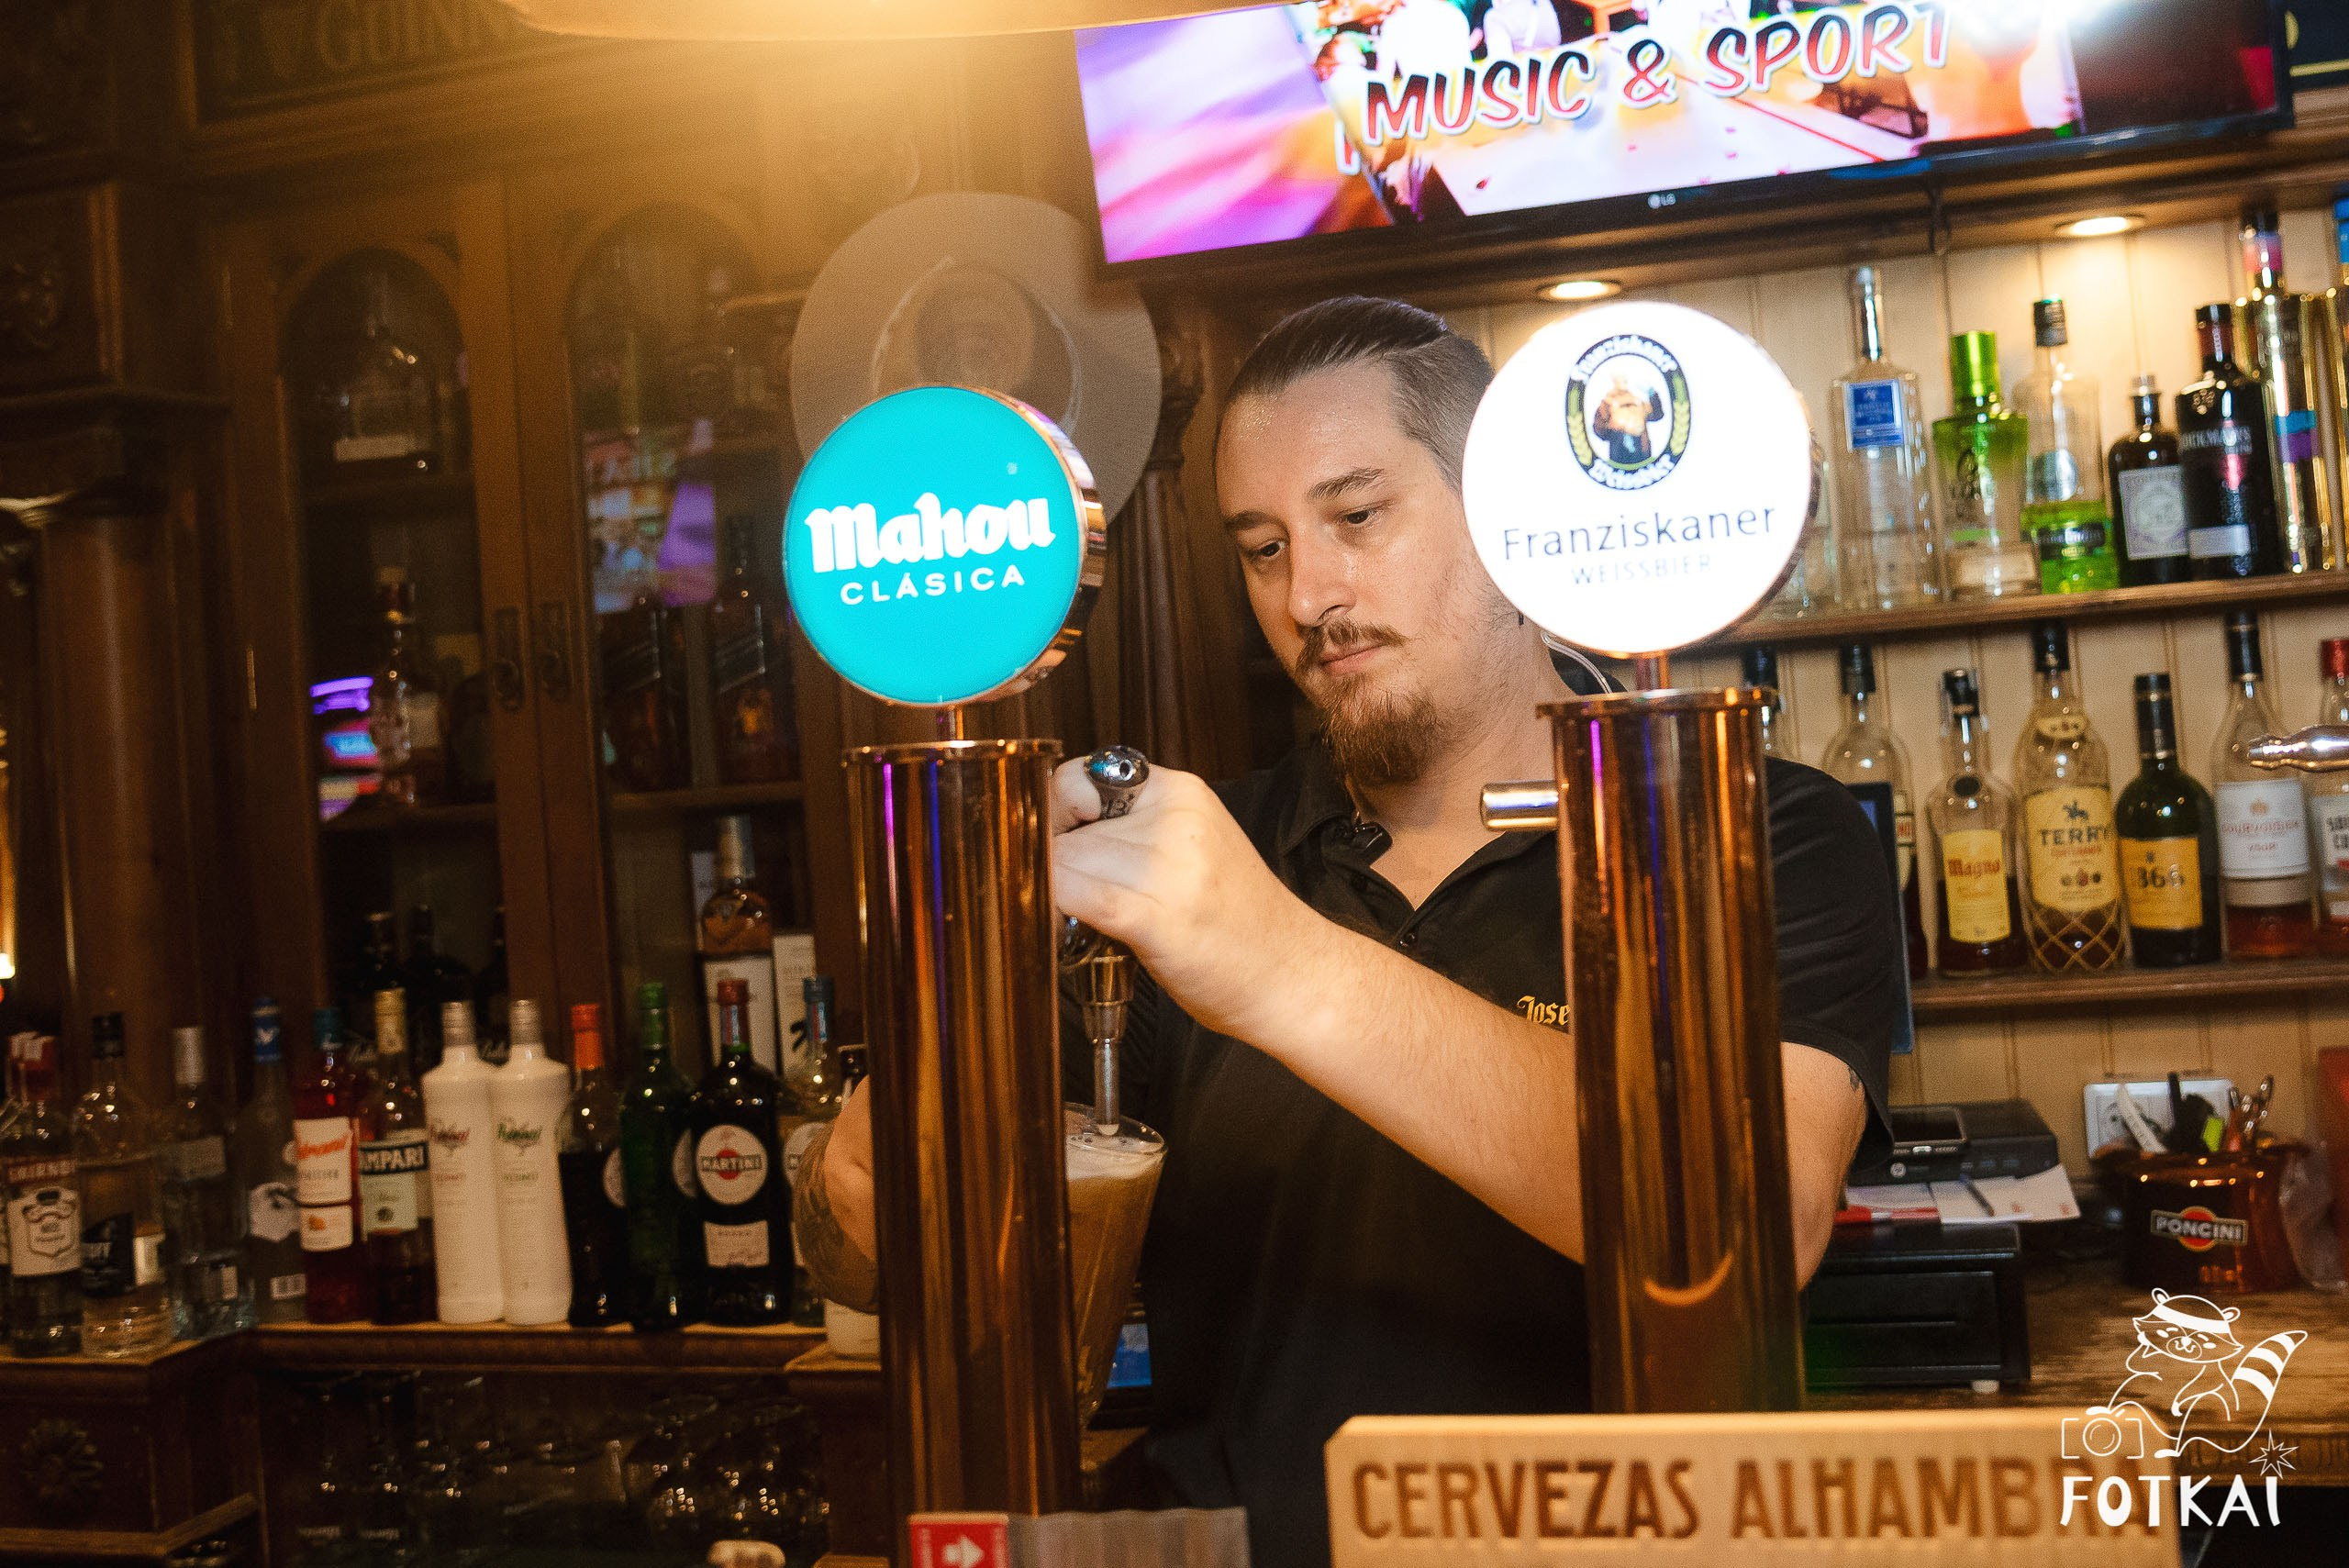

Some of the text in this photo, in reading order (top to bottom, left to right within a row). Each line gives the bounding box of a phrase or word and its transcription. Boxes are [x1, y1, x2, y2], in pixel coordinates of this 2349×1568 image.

[1364, 3, 1949, 142] MUSIC & SPORT
[804, 492, 1056, 573] Mahou
[1504, 507, 1776, 561] Franziskaner
[840, 564, 1026, 606] CLÁSICA
[1571, 554, 1711, 585] WEISSBIER
[1517, 995, 1571, 1026] Jose
[701, 1155, 762, 1172] MARTINI
[2155, 1216, 2242, 1240] PONCINI
[1353, 1460, 1700, 1540] CERVEZAS
